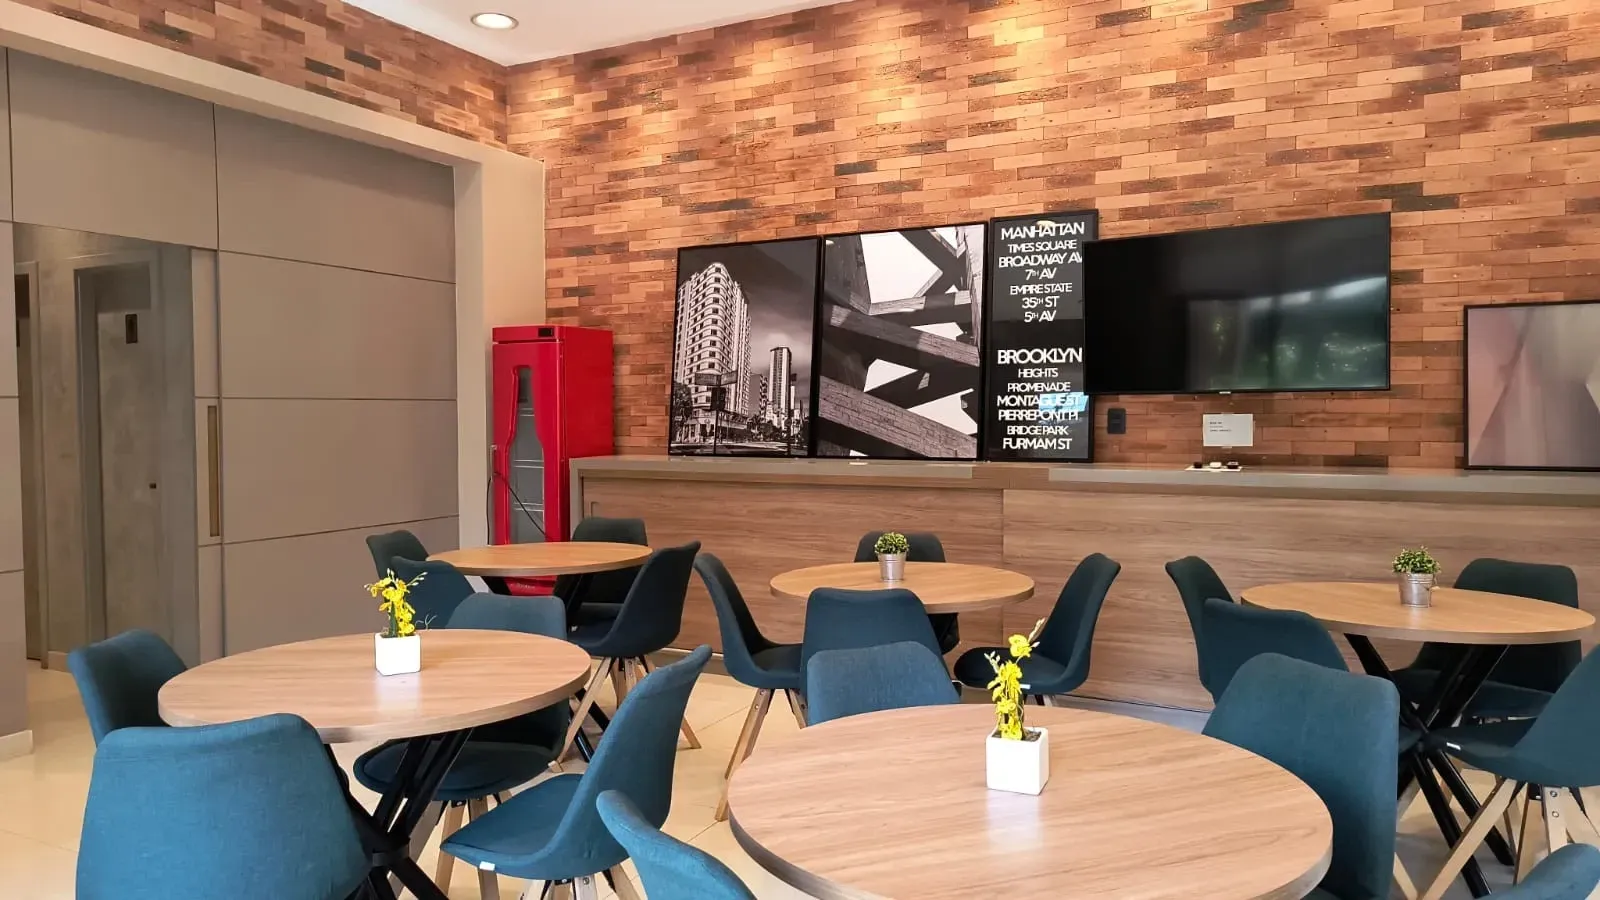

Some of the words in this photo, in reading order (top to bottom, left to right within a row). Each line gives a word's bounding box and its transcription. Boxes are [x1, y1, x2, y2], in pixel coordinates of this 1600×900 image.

[1001, 221, 1085, 240] MANHATTAN
[1008, 242, 1035, 253] TIMES
[1035, 240, 1078, 252] SQUARE
[998, 252, 1068, 268] BROADWAY
[1039, 267, 1057, 280] AV
[1010, 284, 1043, 295] EMPIRE
[1044, 282, 1073, 293] STATE
[1021, 297, 1043, 309] 35TH
[1045, 295, 1060, 308] ST
[1038, 310, 1057, 322] AV
[997, 347, 1083, 365] BROOKLYN
[1018, 367, 1059, 378] HEIGHTS
[1007, 382, 1071, 393] PROMENADE
[1007, 425, 1042, 435] BRIDGE
[1042, 425, 1069, 435] PARK
[1002, 437, 1057, 449] FURMAM
[1057, 437, 1073, 450] ST
